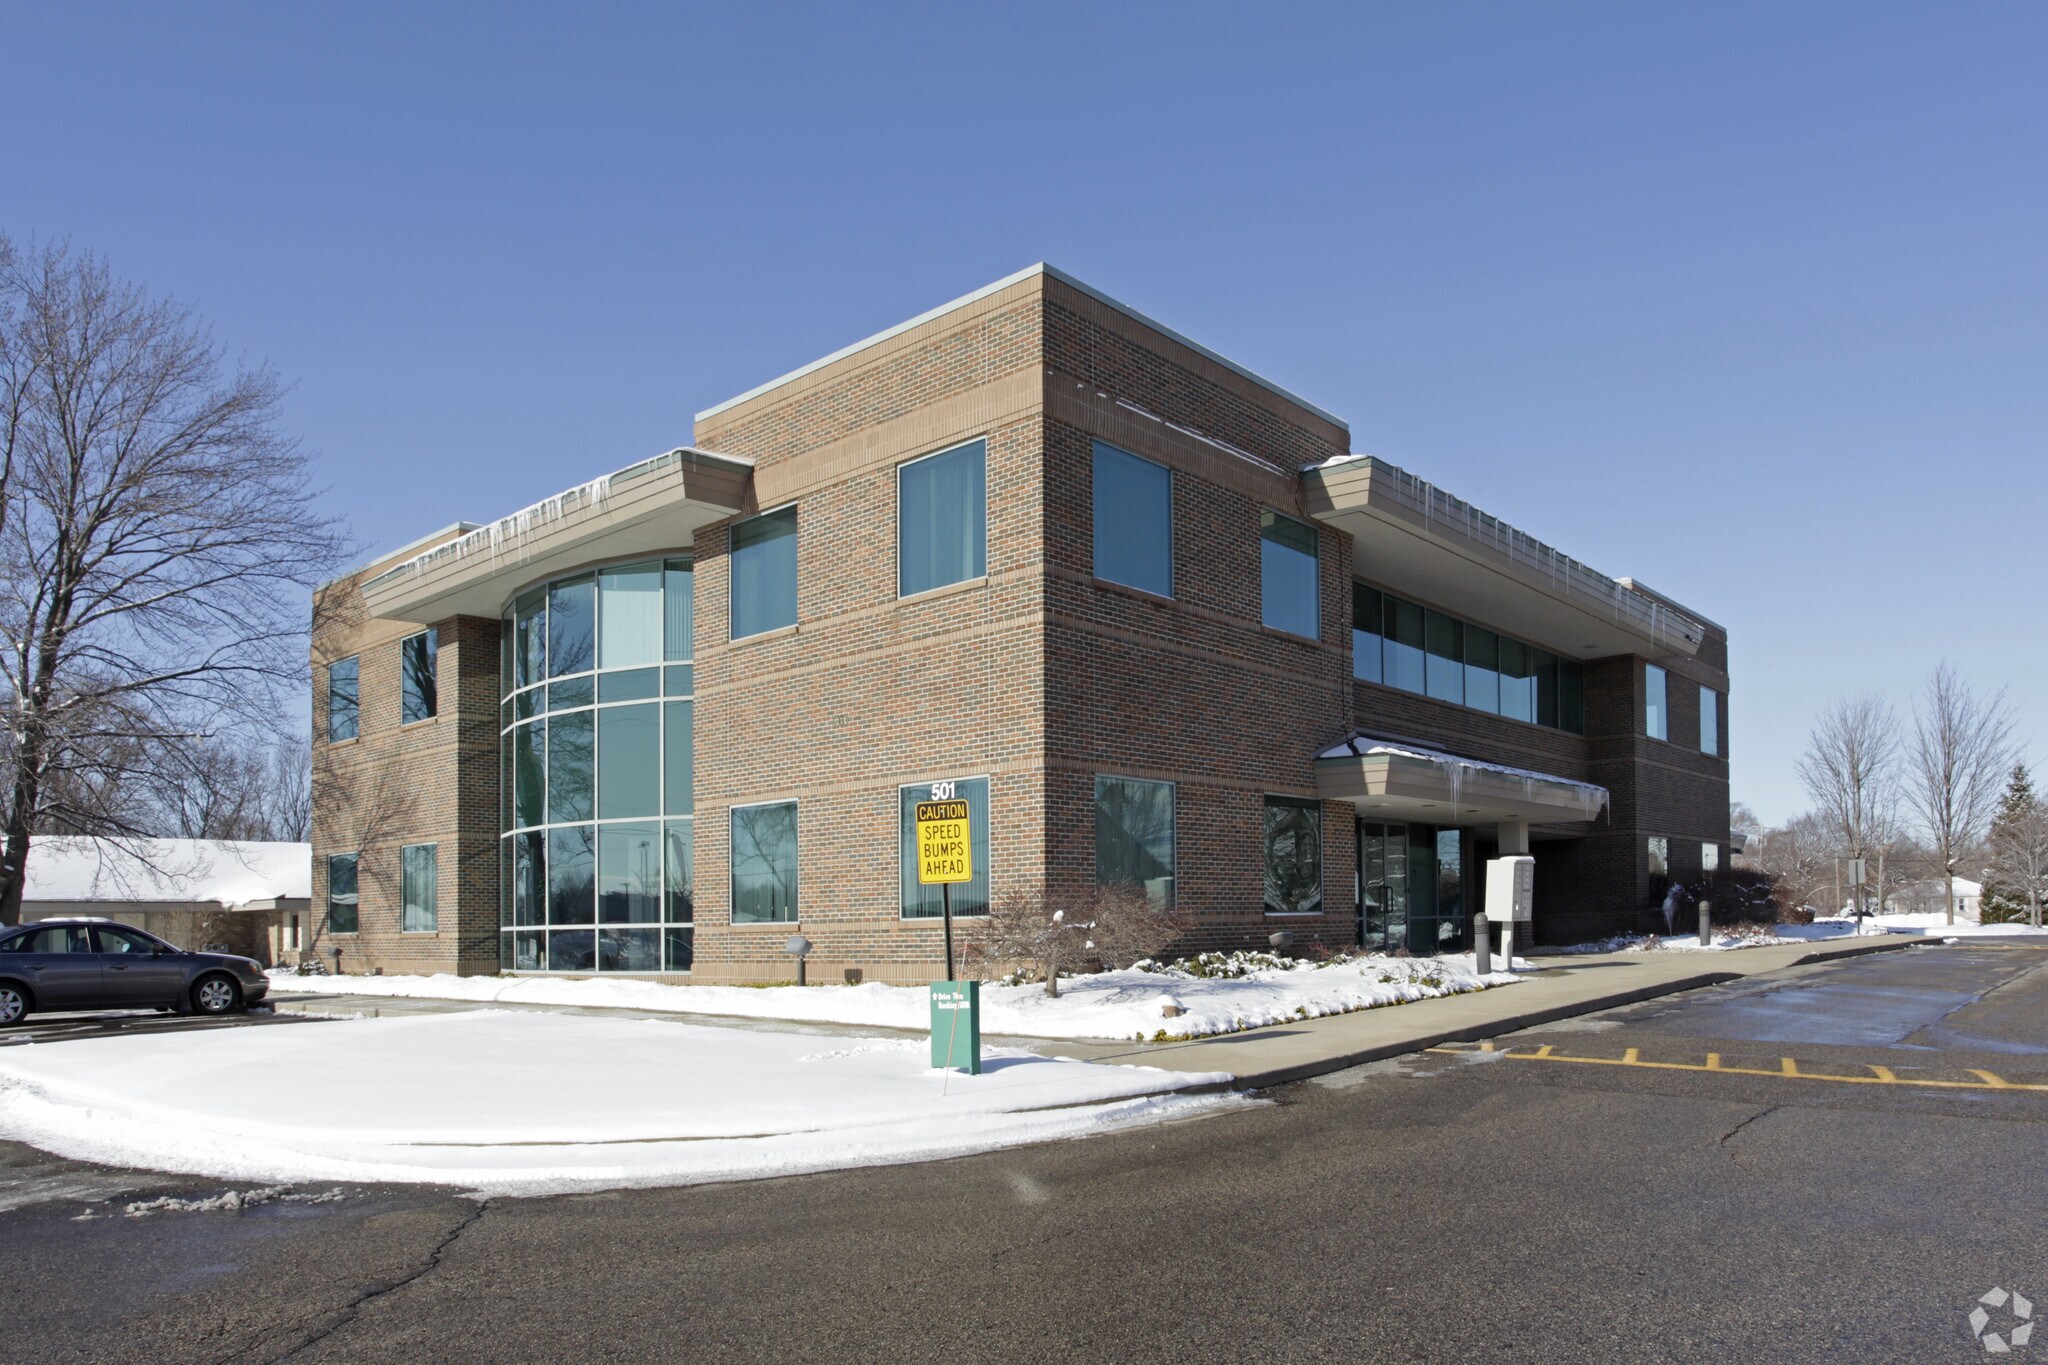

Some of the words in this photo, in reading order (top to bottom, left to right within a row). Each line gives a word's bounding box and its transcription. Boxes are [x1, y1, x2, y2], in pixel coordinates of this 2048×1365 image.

[931, 782, 955, 800] 501
[920, 804, 965, 820] CAUTION
[925, 824, 961, 840] SPEED
[924, 841, 964, 858] BUMPS
[926, 859, 964, 876] AHEAD
